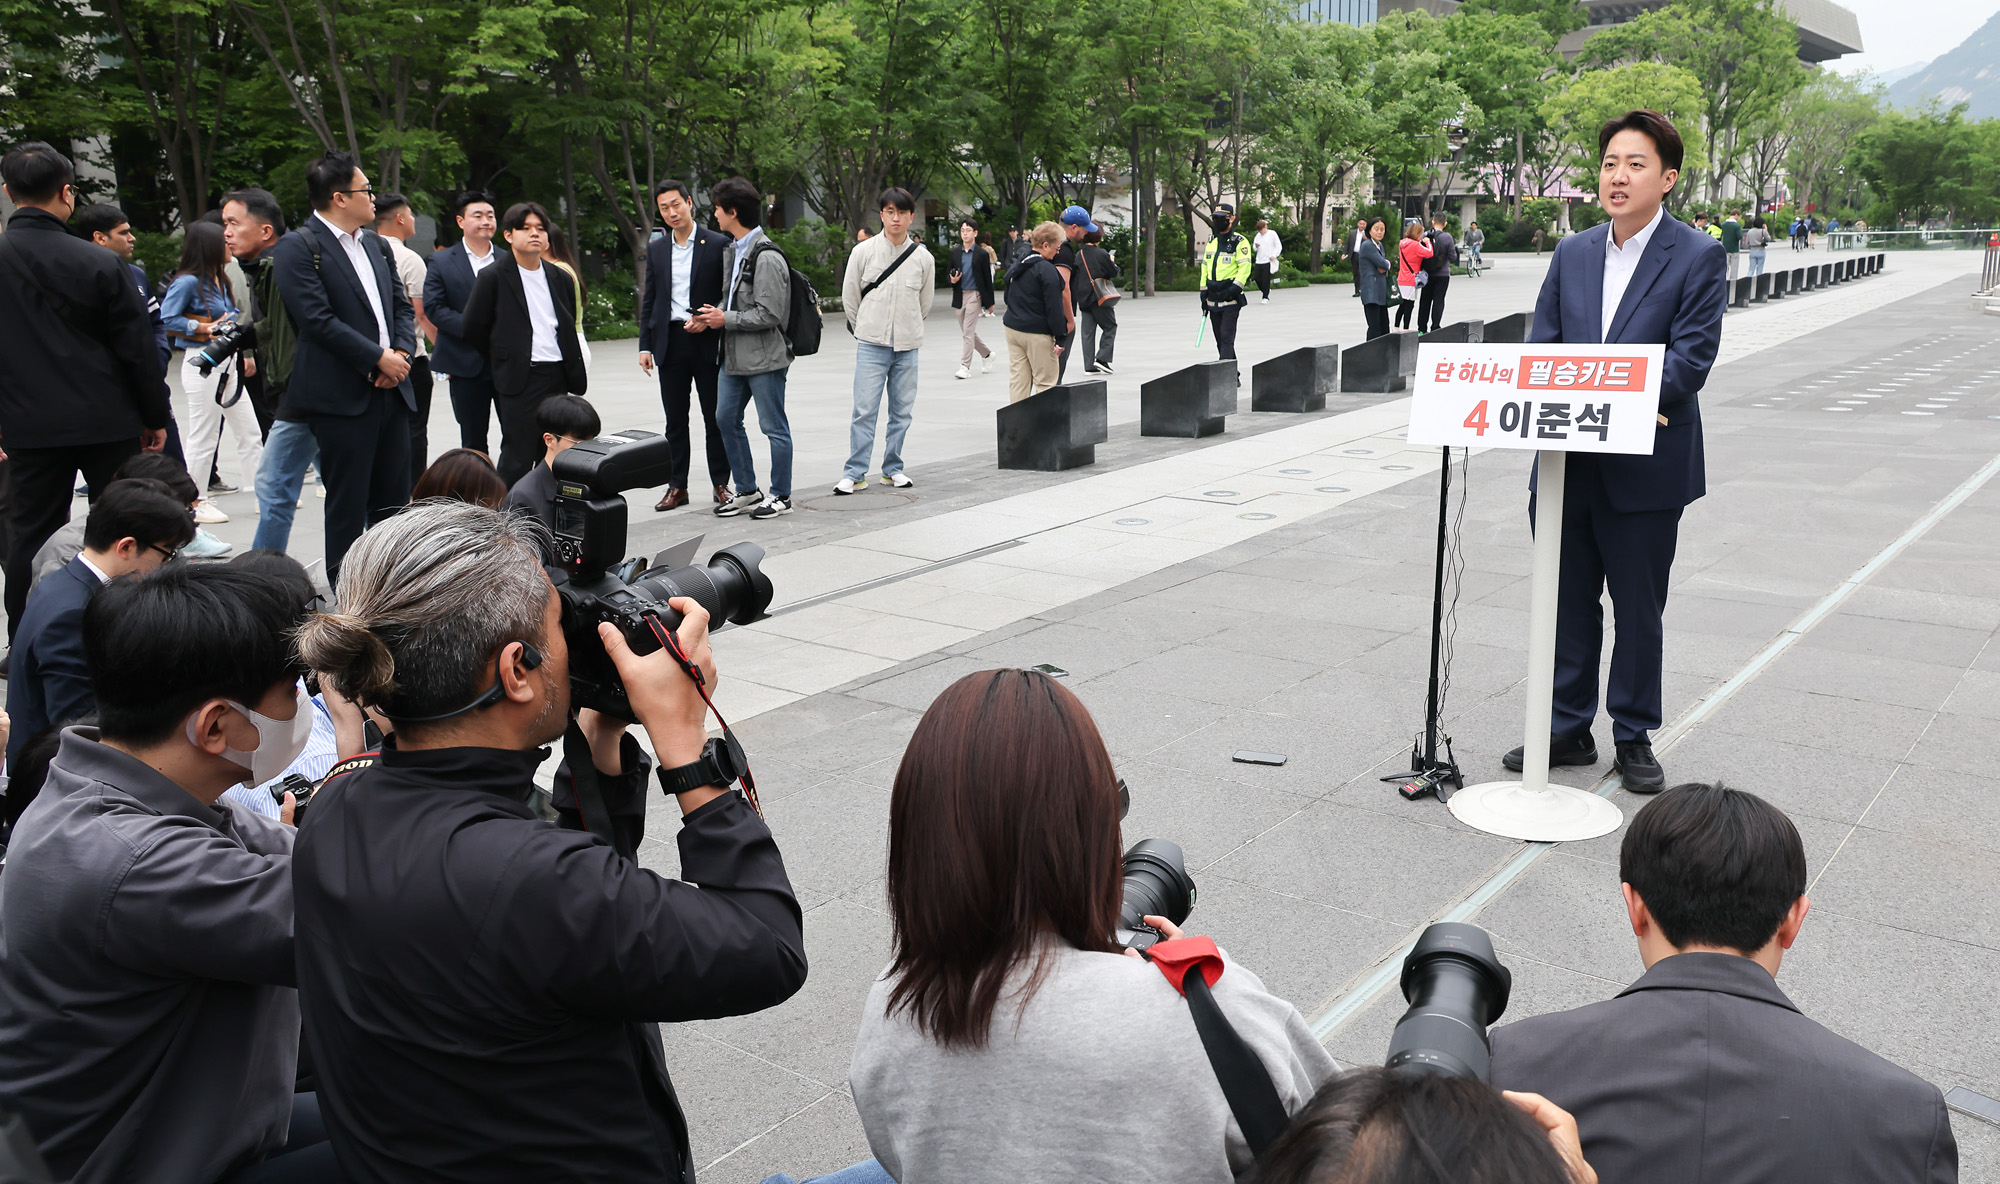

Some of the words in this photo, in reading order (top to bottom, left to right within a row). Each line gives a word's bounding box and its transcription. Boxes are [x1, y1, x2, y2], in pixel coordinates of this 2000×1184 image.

[1434, 362, 1455, 382] 단
[1458, 362, 1514, 384] 하나의
[1527, 360, 1632, 387] 필승카드
[1463, 400, 1490, 436] 4
[1499, 401, 1611, 442] 이준석
